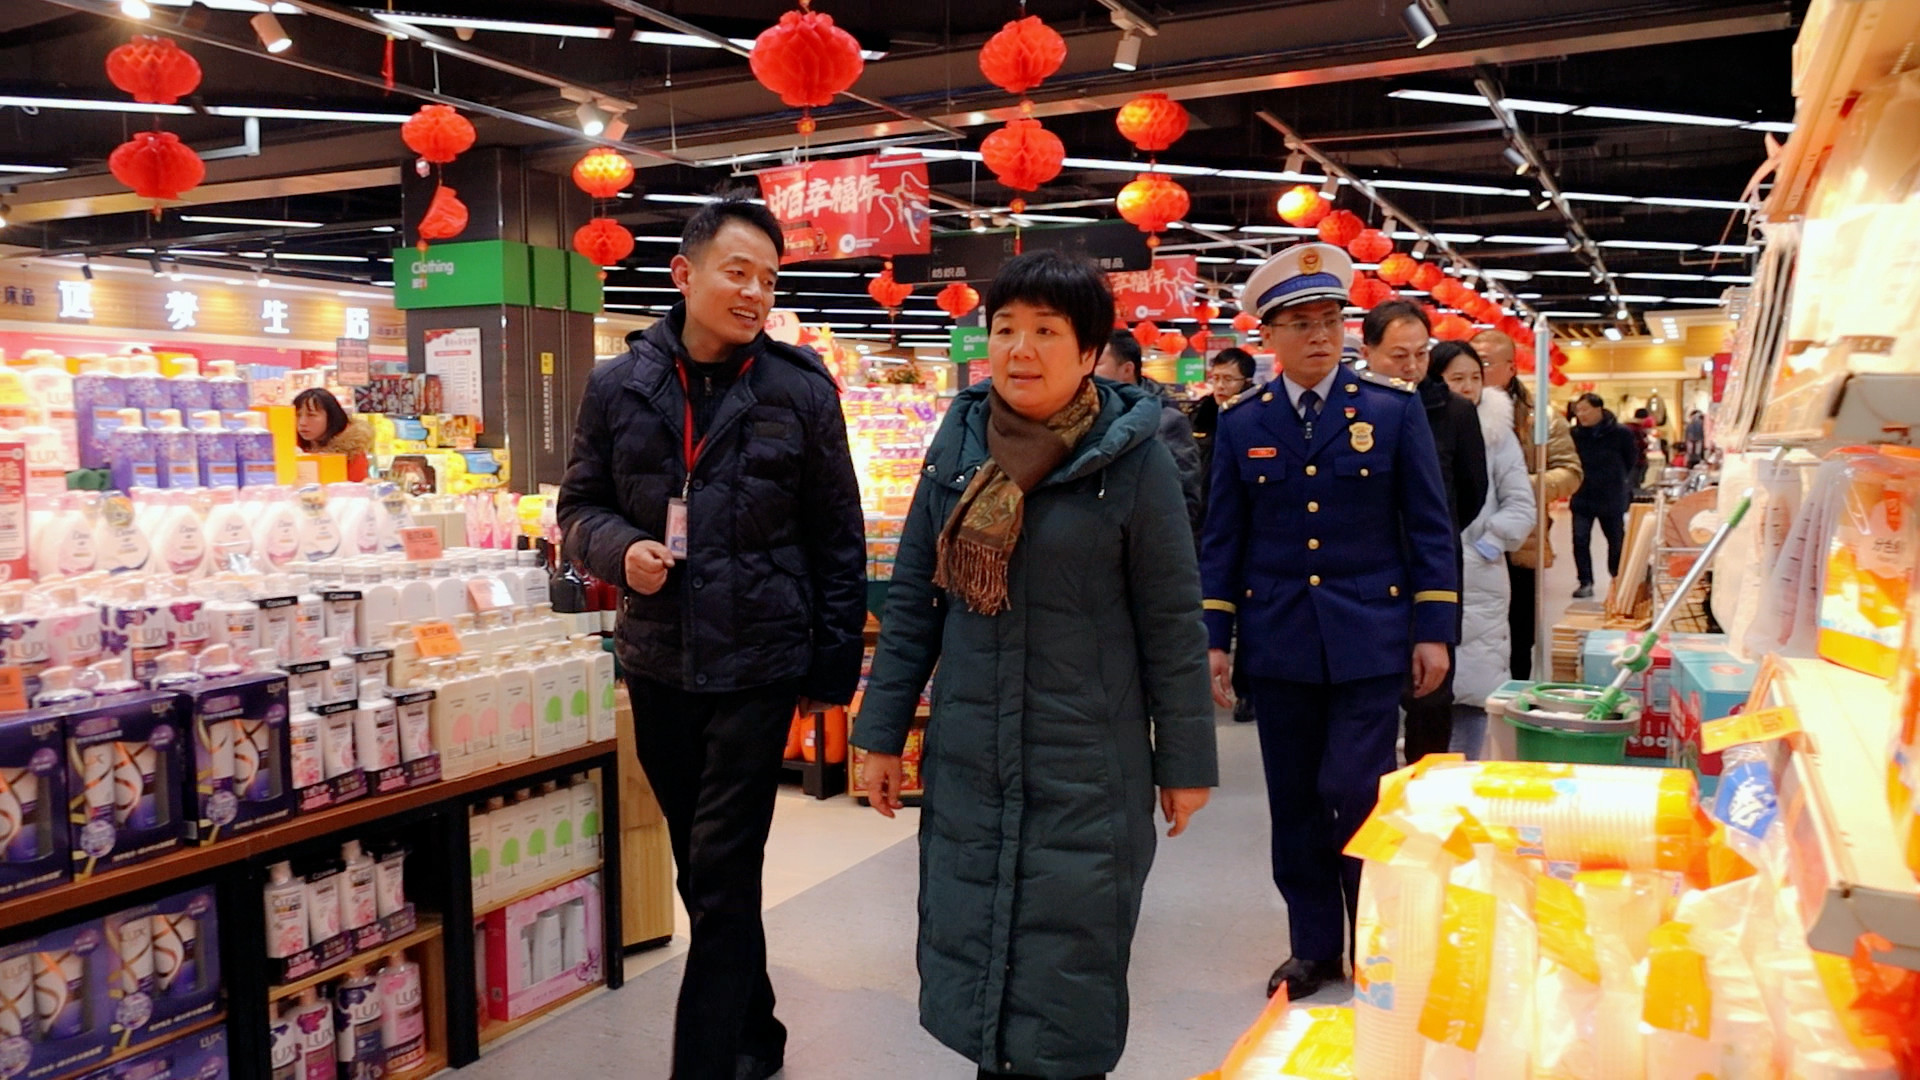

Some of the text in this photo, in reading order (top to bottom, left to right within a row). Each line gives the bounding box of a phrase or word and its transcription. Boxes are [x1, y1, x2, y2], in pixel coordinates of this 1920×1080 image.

[411, 261, 454, 276] Clothing
[931, 266, 967, 279] 纺织品
[66, 632, 101, 651] LUX
[131, 627, 165, 644] LUX
[9, 641, 48, 660] LUX
[396, 985, 420, 1006] LUX
[354, 1001, 380, 1020] LUX
[306, 1027, 334, 1048] LUX
[273, 1044, 295, 1062] UX
